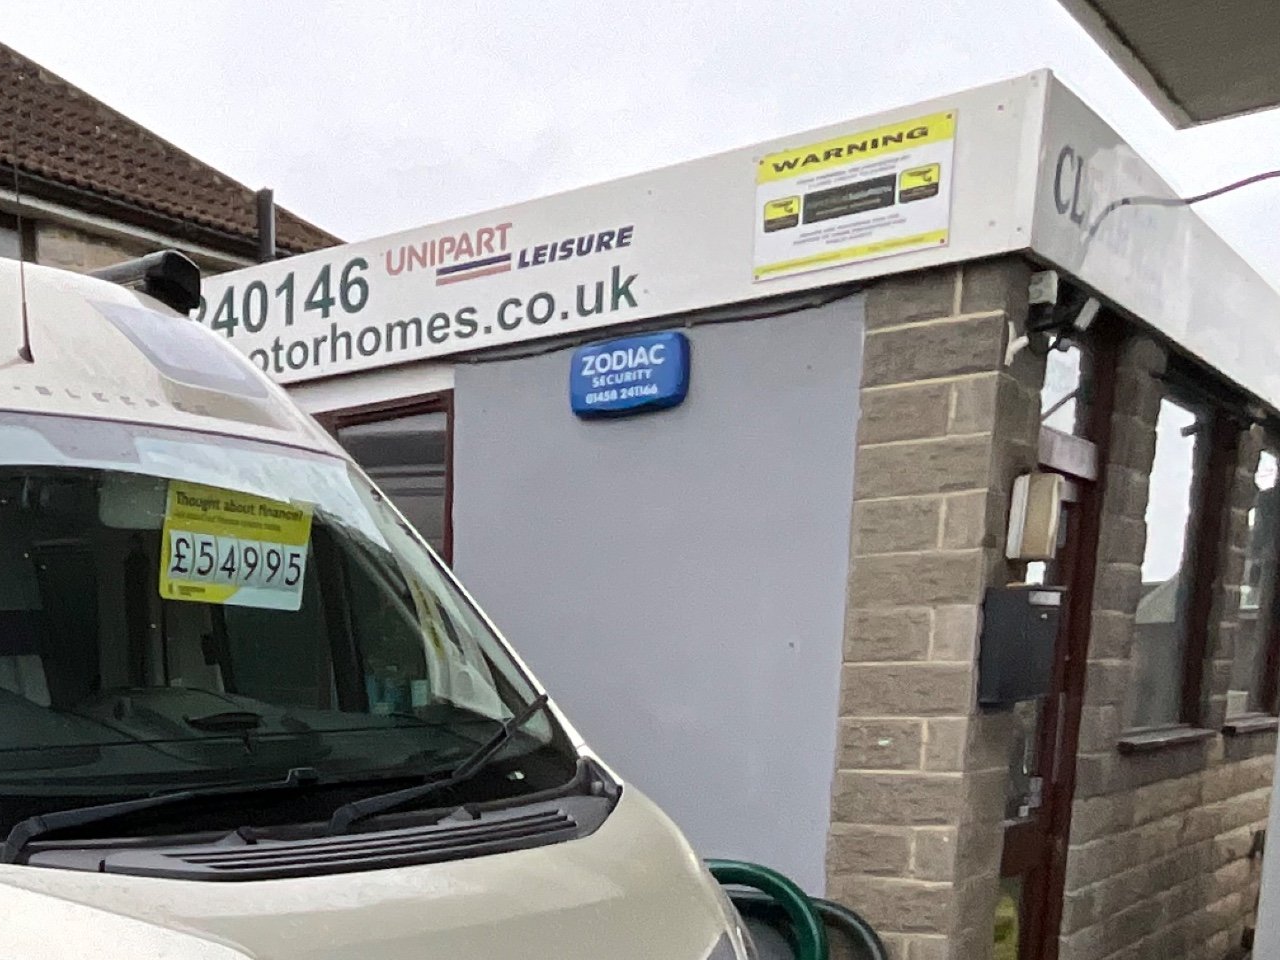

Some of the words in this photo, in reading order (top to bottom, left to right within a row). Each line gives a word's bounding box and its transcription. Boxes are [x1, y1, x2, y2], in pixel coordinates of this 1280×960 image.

[773, 126, 929, 173] WARNING
[385, 222, 513, 276] UNIPART
[517, 225, 634, 270] LEISURE
[581, 343, 665, 376] ZODIAC
[592, 368, 653, 388] SECURITY
[171, 537, 302, 586] £54995
